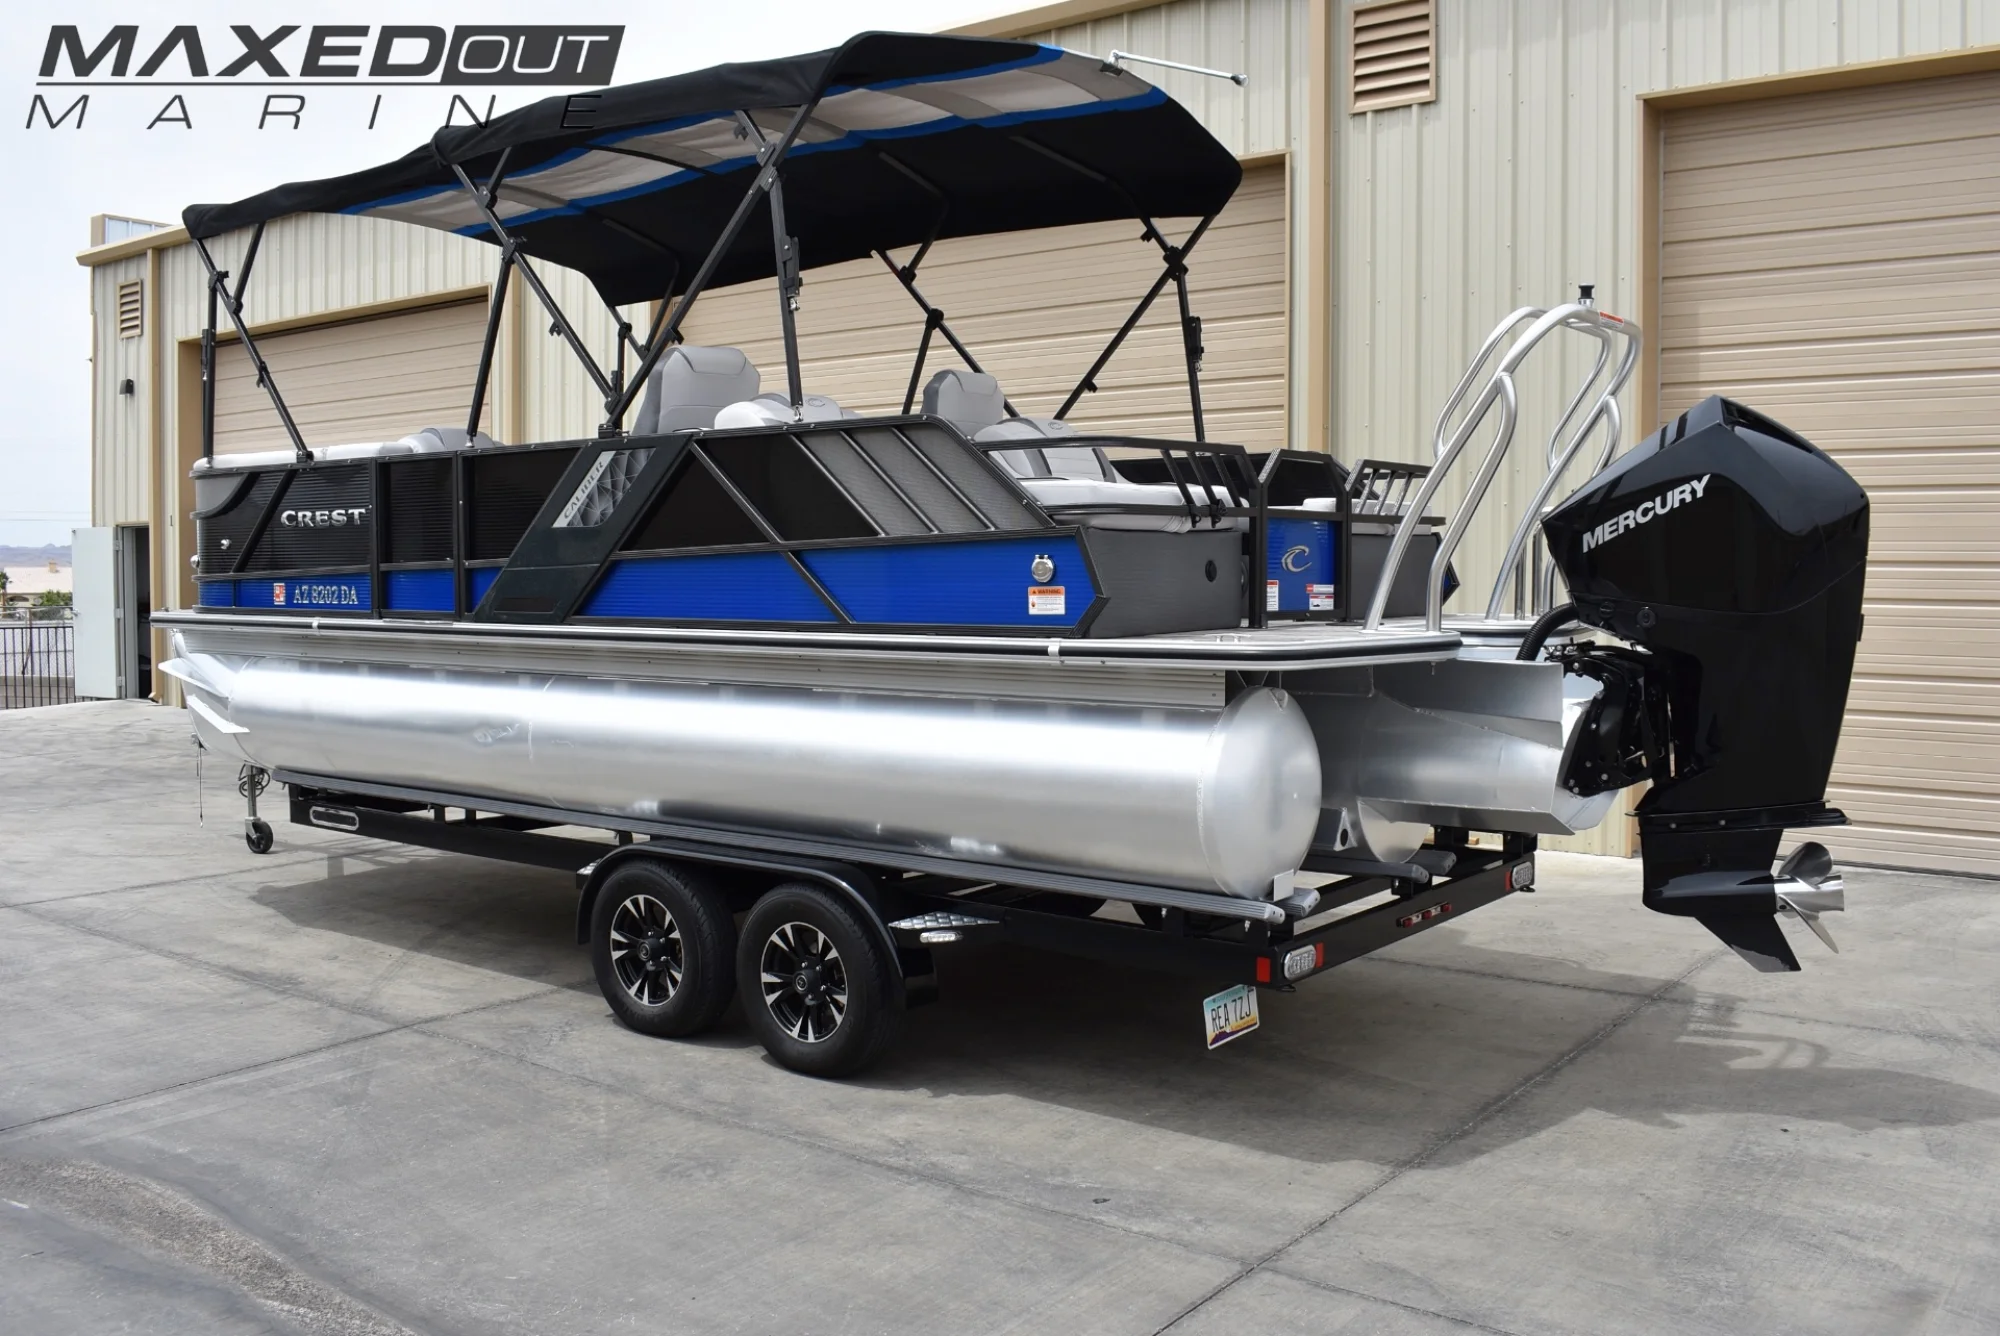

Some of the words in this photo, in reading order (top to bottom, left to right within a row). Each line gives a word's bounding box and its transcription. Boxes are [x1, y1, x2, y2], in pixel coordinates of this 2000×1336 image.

[280, 508, 367, 529] CREST
[1582, 473, 1712, 554] MERCURY
[293, 585, 310, 604] AZ
[311, 585, 339, 604] 8202
[341, 585, 359, 605] DA
[1211, 1002, 1231, 1033] REA
